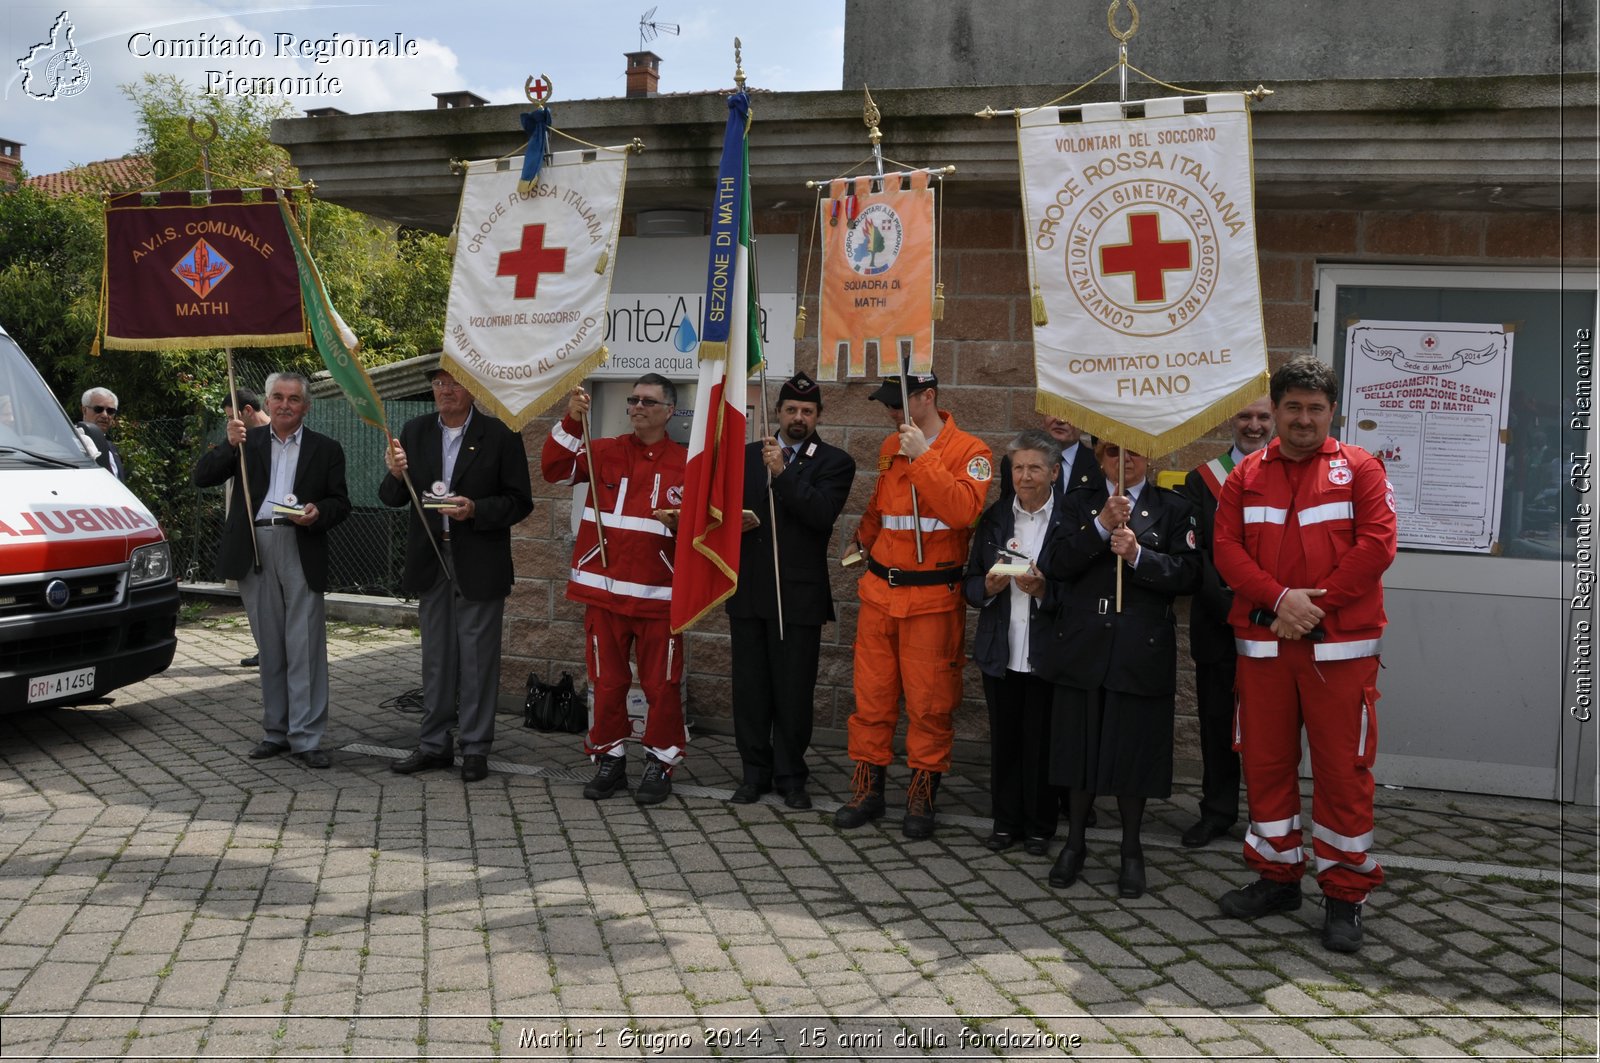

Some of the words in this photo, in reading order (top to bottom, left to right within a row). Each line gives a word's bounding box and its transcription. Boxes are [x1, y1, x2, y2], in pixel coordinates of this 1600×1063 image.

[1055, 134, 1121, 153] VOLONTARI
[1129, 132, 1151, 148] DEL
[1157, 127, 1217, 145] SOCCORSO
[718, 177, 735, 225] MATHI
[1036, 177, 1085, 251] CROCE
[1082, 150, 1165, 186] ROSSA
[1170, 153, 1247, 238] ITALIANA
[1112, 183, 1189, 211] GINEVRA
[467, 203, 506, 254] CROCE
[562, 188, 603, 246] ITALIANA
[1088, 200, 1108, 221] DI
[1190, 208, 1209, 230] 22
[131, 227, 182, 264] A.V.I.S.
[185, 220, 275, 260] COMUNALE
[716, 231, 731, 247] DI
[1071, 223, 1135, 330] CONVENZIONE
[1196, 234, 1215, 296] AGOSTO
[709, 254, 730, 322] SEZIONE
[843, 280, 888, 291] SQUADRA
[175, 301, 230, 317] MATHI
[854, 297, 887, 308] MATHI
[1167, 294, 1201, 327] 1864
[469, 314, 513, 328] VOLONTARI
[514, 313, 529, 325] DEL
[530, 310, 581, 325] SOCCORSO
[452, 324, 470, 352] SAN
[463, 348, 533, 381] FRANCESCO
[537, 357, 555, 375] AL
[555, 316, 598, 361] CAMPO
[1376, 349, 1393, 357] 1999
[1464, 352, 1481, 360] 2014
[612, 355, 651, 369] fresca
[654, 358, 693, 372] acqua
[1068, 353, 1161, 375] COMITATO
[1165, 348, 1232, 369] LOCALE
[1403, 361, 1421, 371] Sede
[1431, 362, 1452, 371] Mathi
[1116, 374, 1192, 398] FIANO
[1355, 375, 1439, 394] FESTEGGIAMENTI
[1441, 378, 1457, 391] DEI
[1460, 383, 1471, 393] 15
[1472, 387, 1497, 399] ANNI
[1364, 390, 1394, 400] DELLA
[1396, 387, 1458, 401] FONDAZIONE
[1460, 393, 1490, 405] DELLA
[1379, 399, 1404, 409] SEDE
[1408, 399, 1426, 410] CRI
[1430, 400, 1440, 410] DI
[1442, 401, 1474, 412] MATHI
